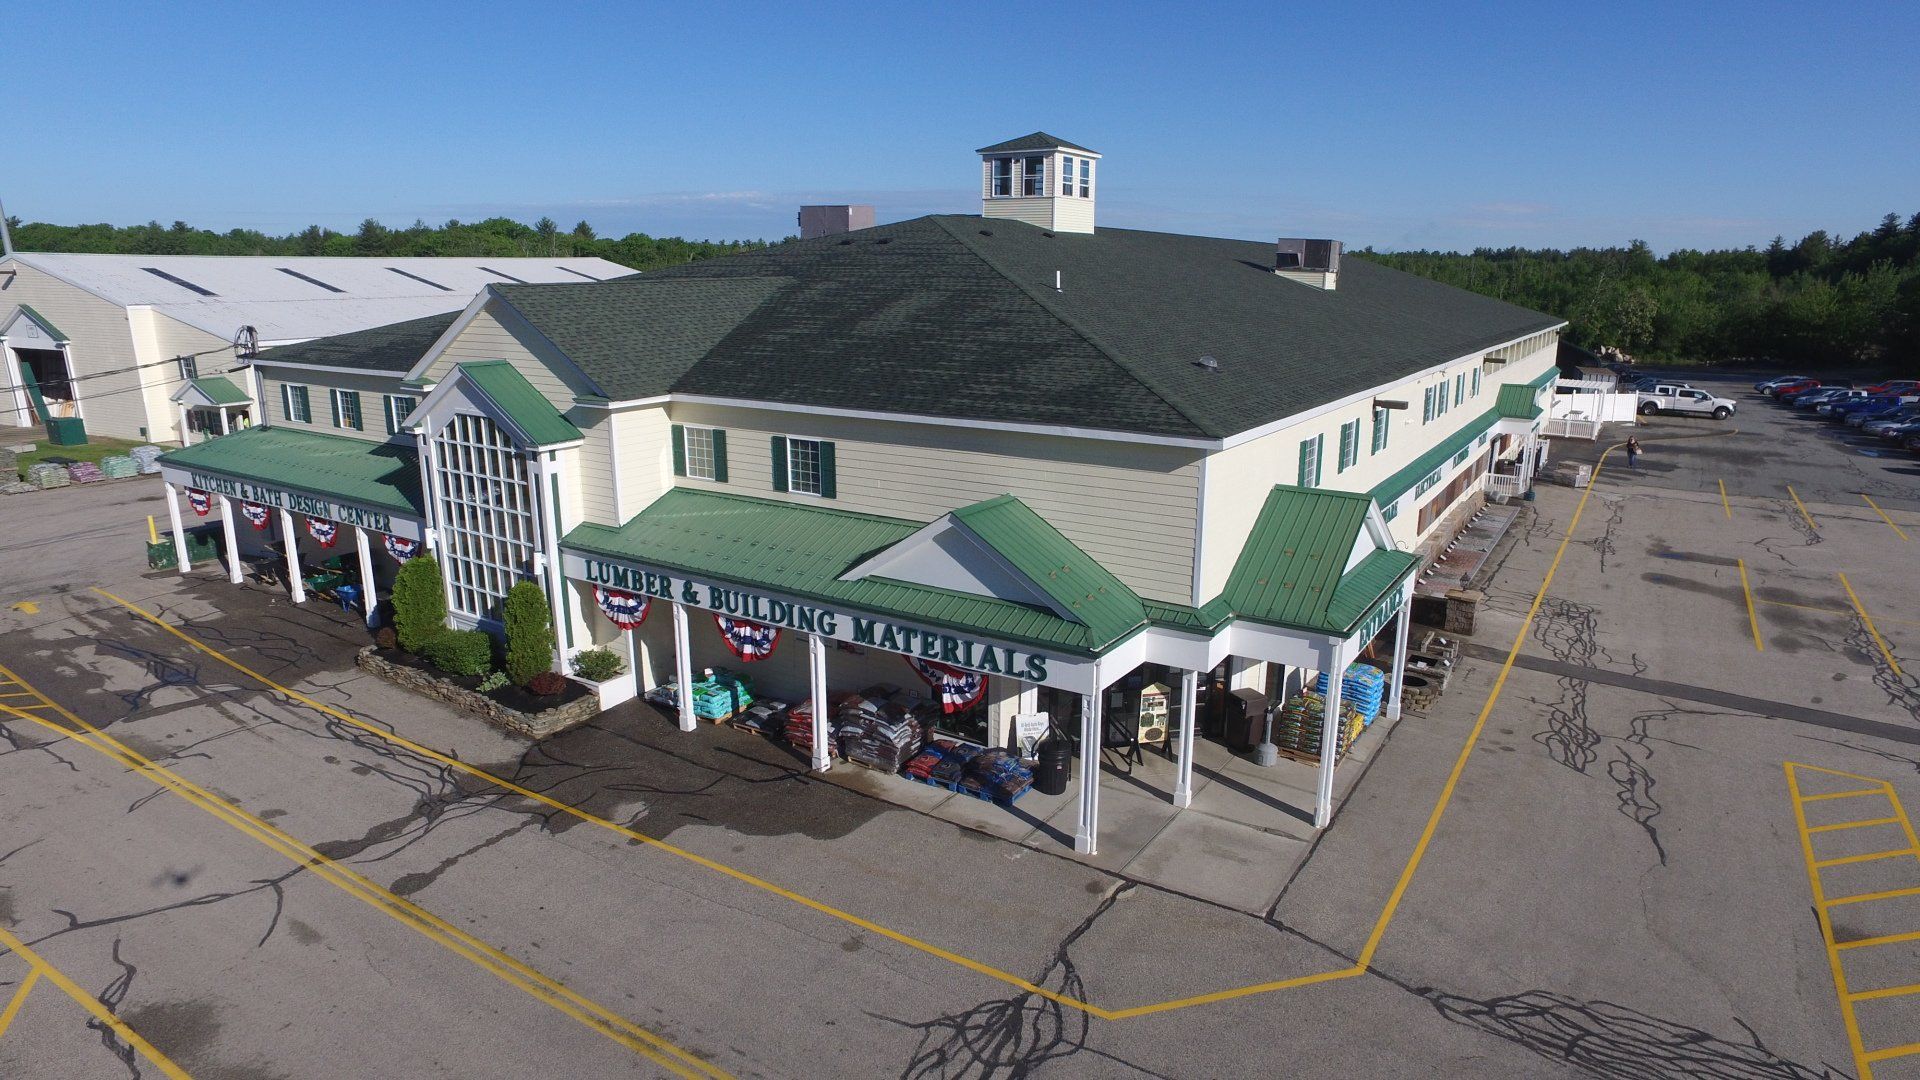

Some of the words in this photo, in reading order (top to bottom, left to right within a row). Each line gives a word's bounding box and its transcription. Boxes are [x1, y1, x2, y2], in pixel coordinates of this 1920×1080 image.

[191, 472, 237, 497] KITCHEN
[240, 483, 250, 499] &
[252, 486, 283, 507] BATH
[288, 493, 332, 519] DESIGN
[338, 504, 393, 533] CENTER
[584, 559, 675, 600] LUMBER
[681, 579, 701, 606] &
[708, 585, 838, 636] BUILDING
[851, 616, 1049, 683] MATERIALS
